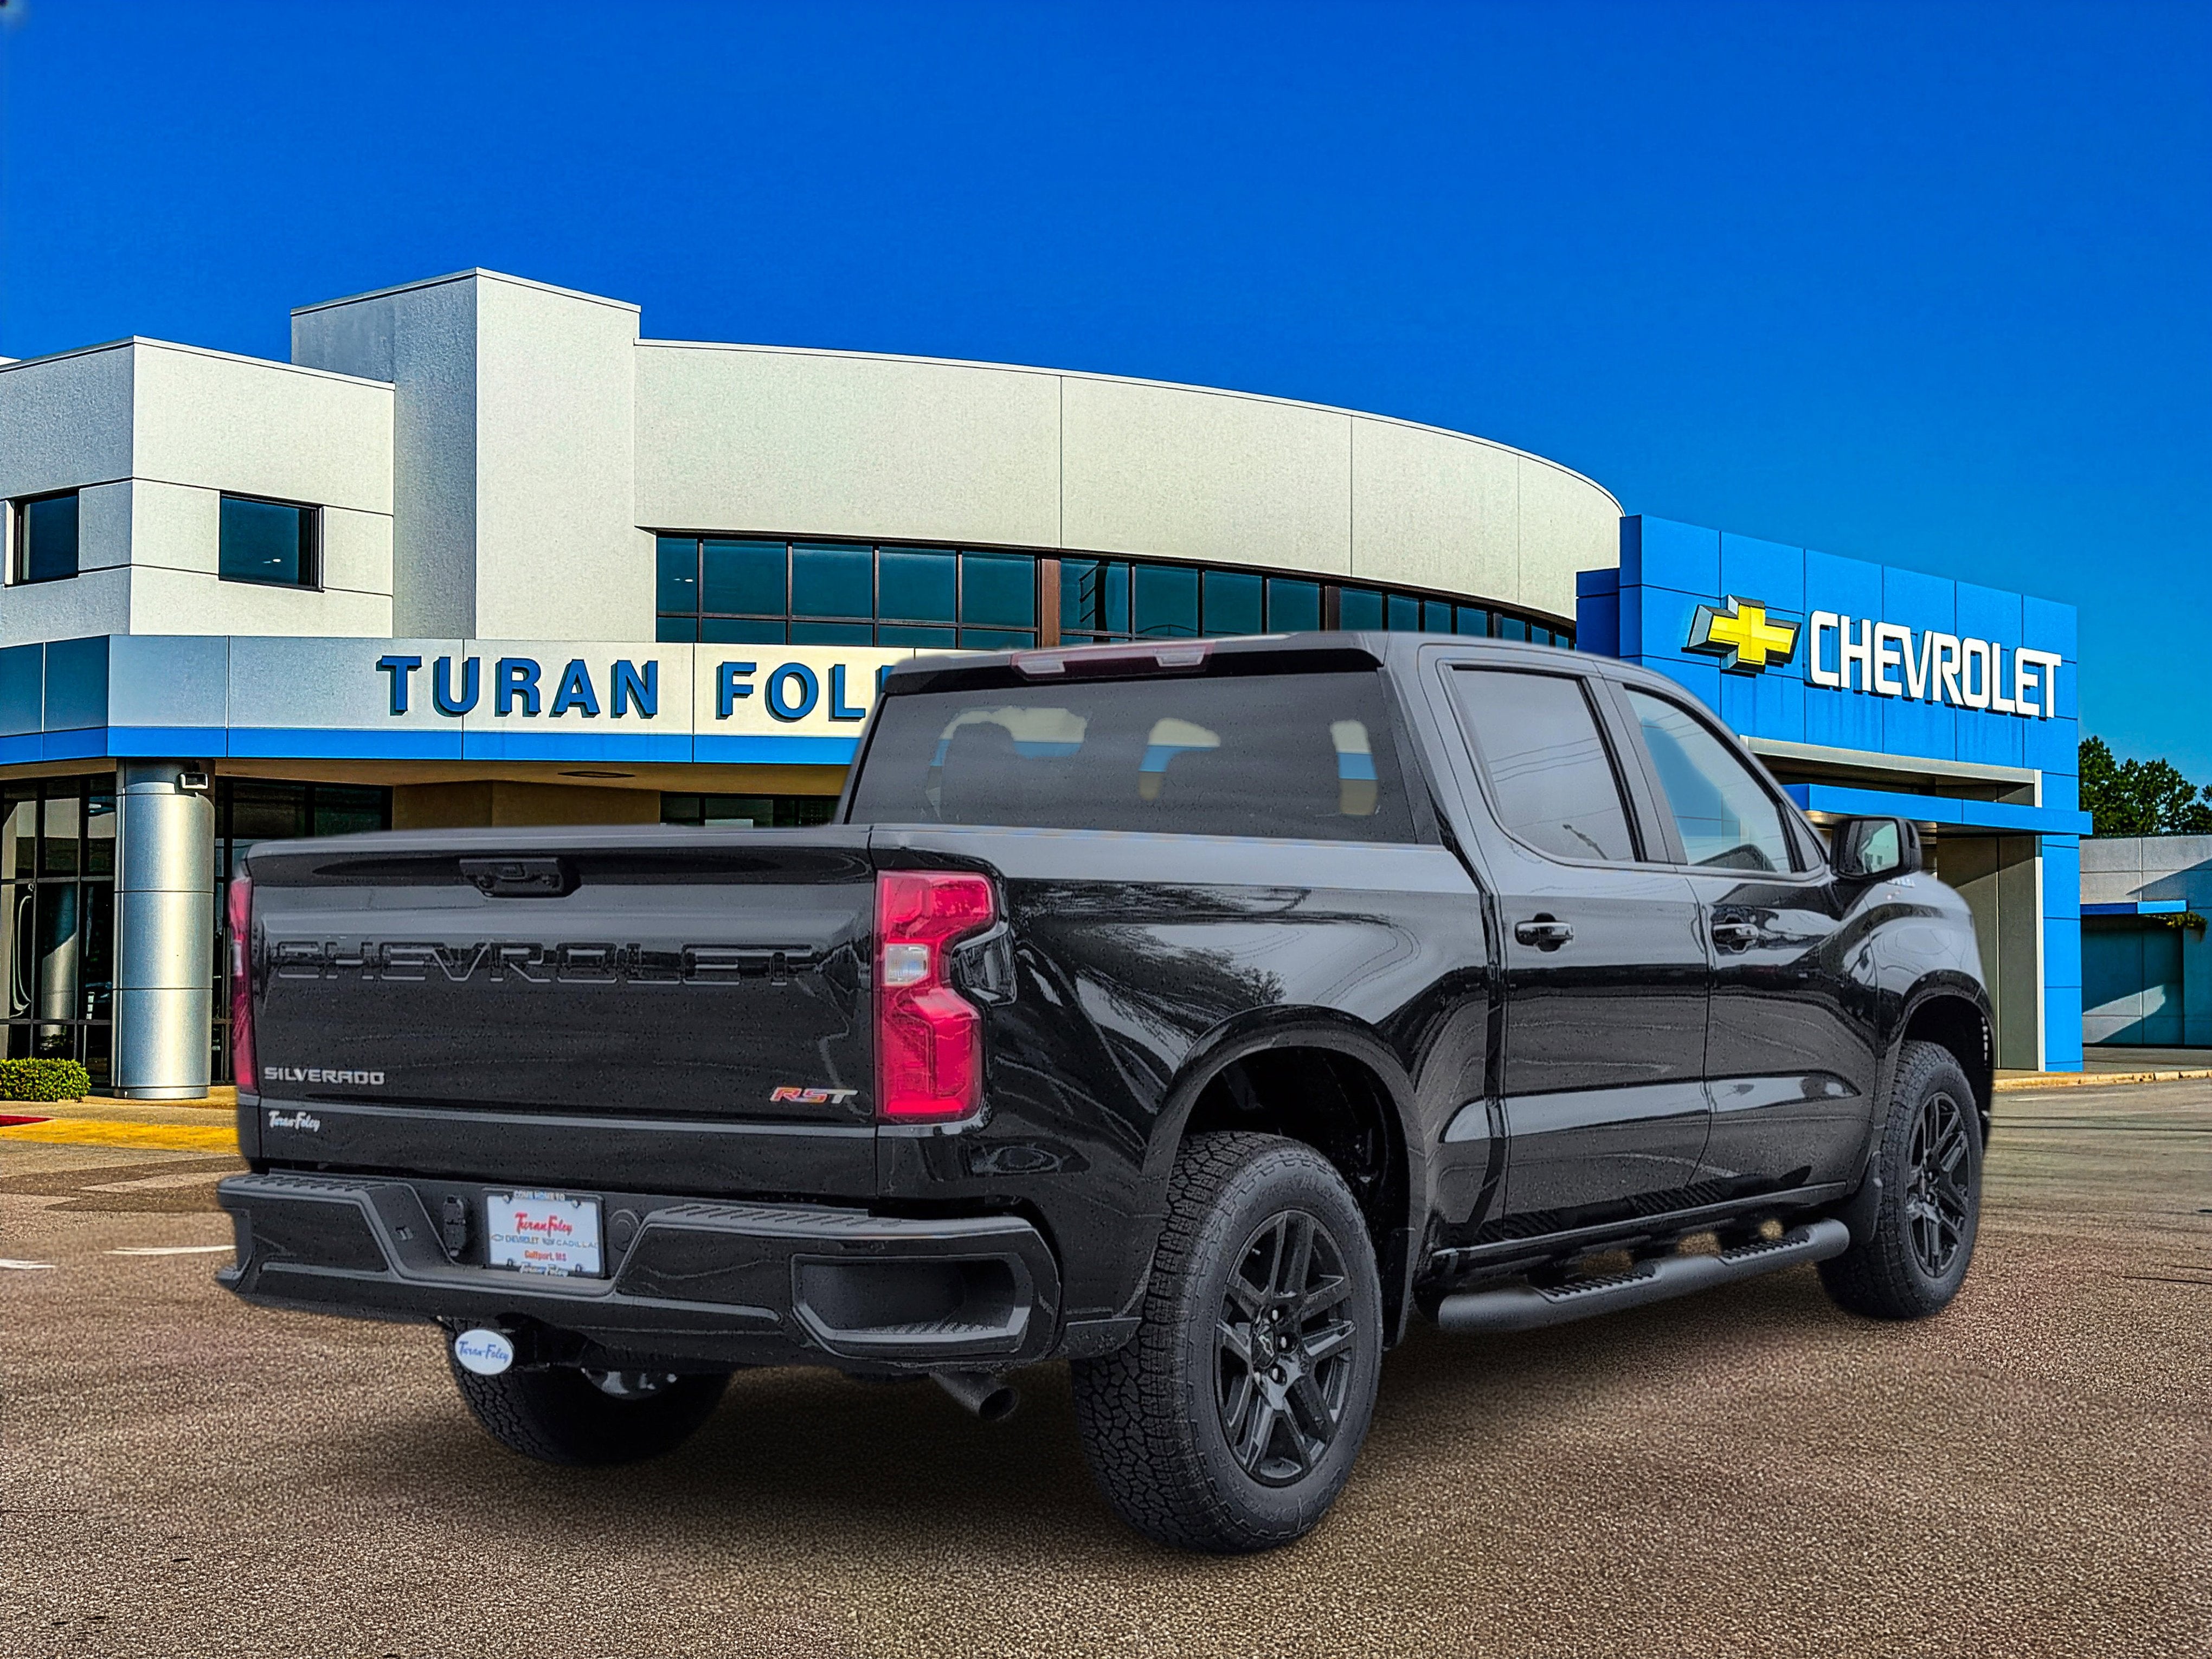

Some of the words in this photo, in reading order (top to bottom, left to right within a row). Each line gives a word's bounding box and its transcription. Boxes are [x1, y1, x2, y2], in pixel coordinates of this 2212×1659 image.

[1810, 610, 2062, 719] CHEVROLET
[377, 655, 659, 719] TURAN
[277, 942, 813, 986] CHEVROLET
[264, 1066, 385, 1085] SILVERADO
[770, 1086, 859, 1104] RST
